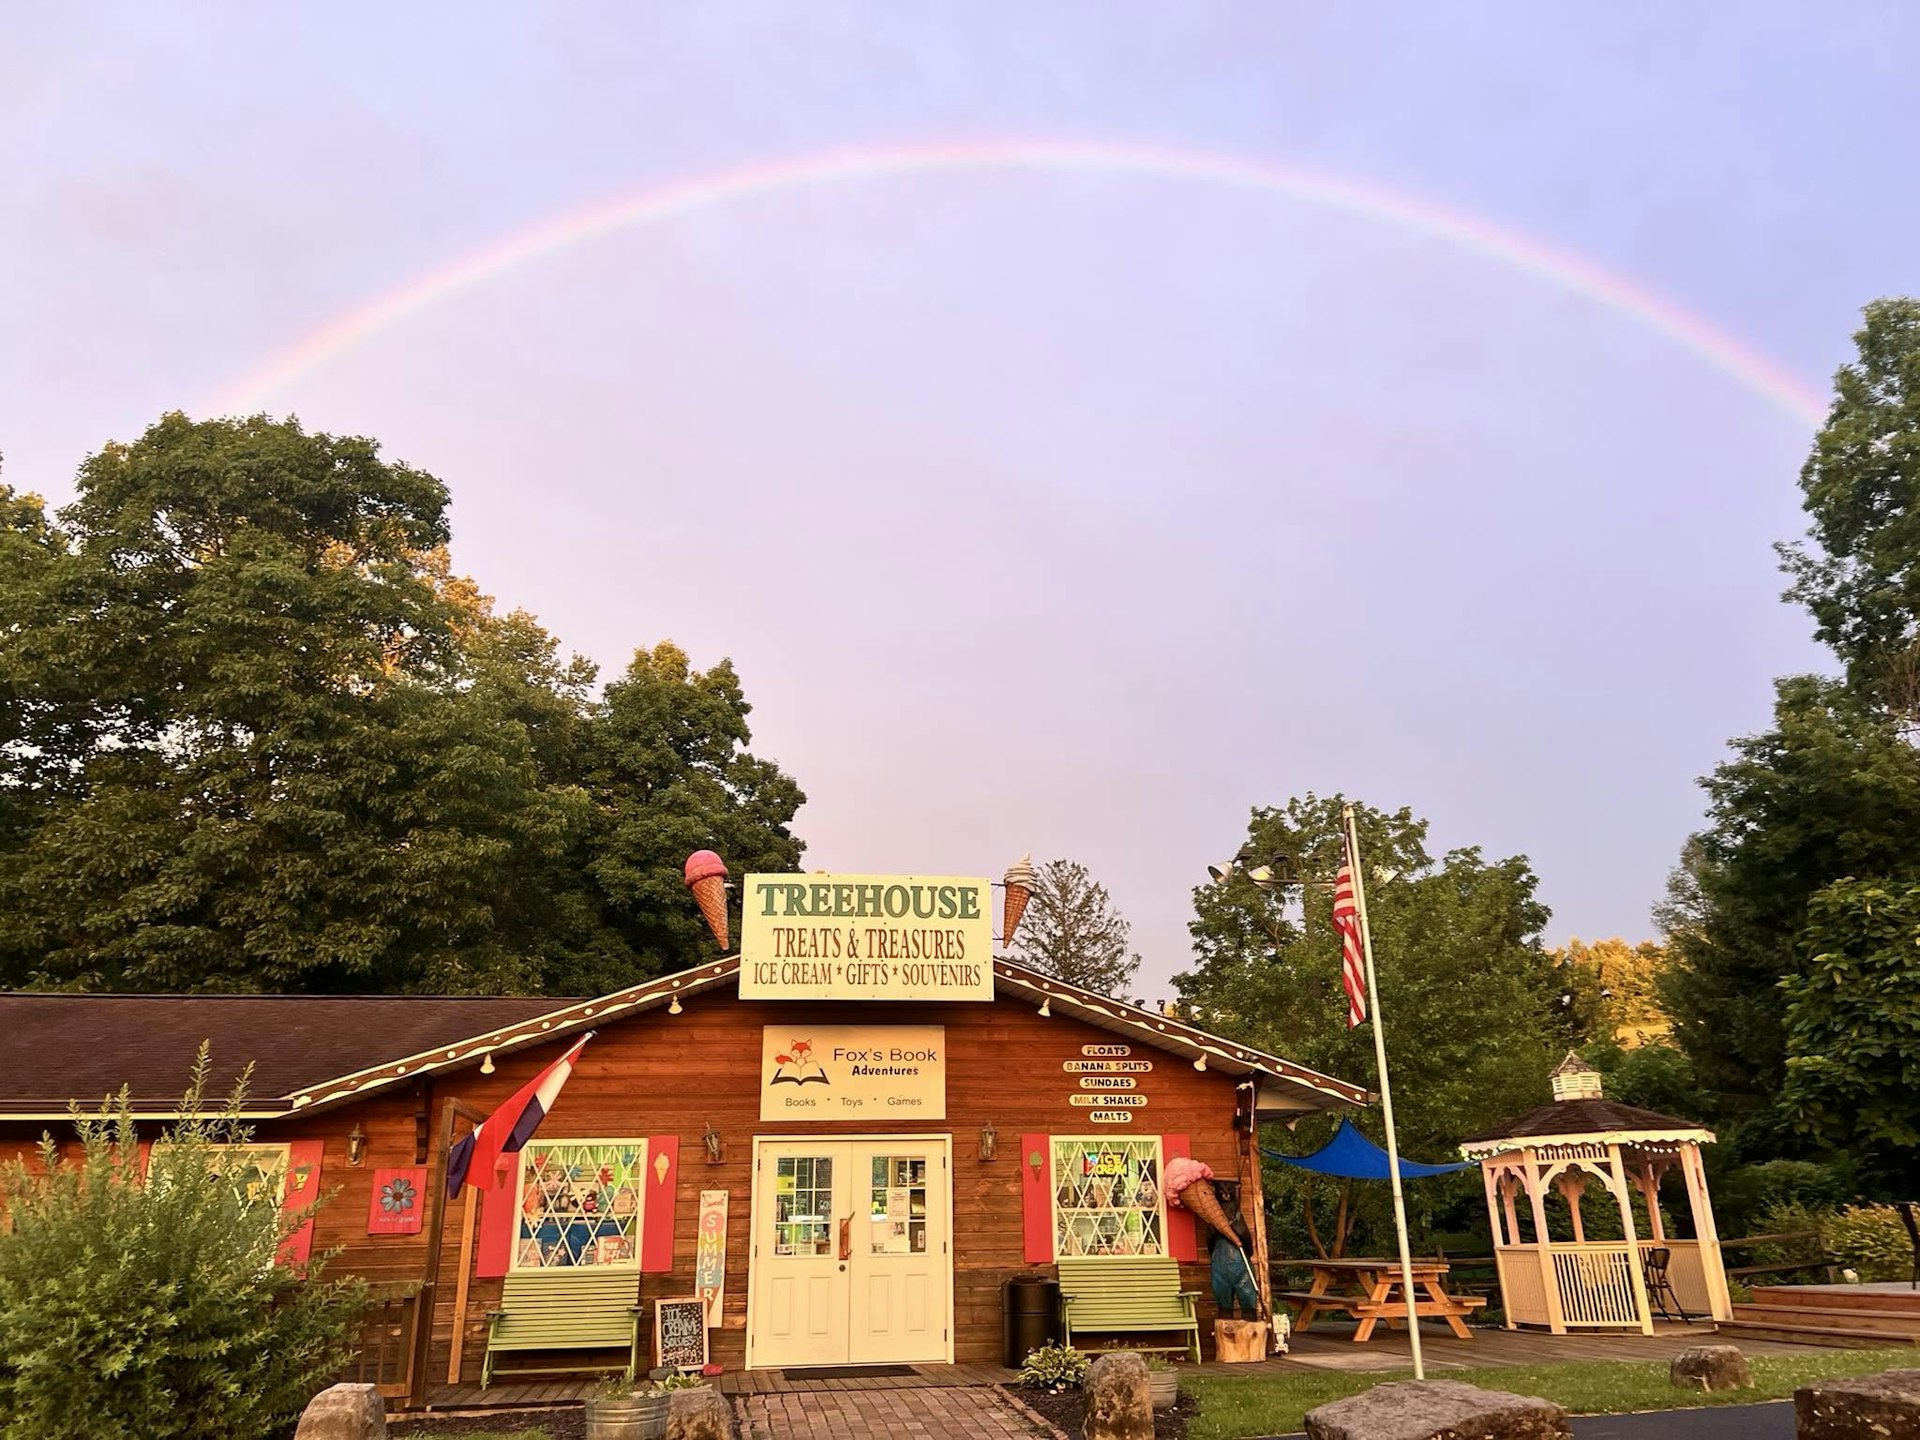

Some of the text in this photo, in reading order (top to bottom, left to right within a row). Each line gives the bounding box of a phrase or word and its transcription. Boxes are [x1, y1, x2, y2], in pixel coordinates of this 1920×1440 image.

[756, 883, 981, 919] TREEHOUSE
[772, 927, 965, 960] TREATS & TREASURES
[753, 962, 981, 987] ICE CREAM GIFTS SOUVENIRS
[833, 1048, 937, 1062] Fox's Book
[1086, 1046, 1126, 1055] FLOATS
[852, 1065, 919, 1076] Adventures
[1066, 1062, 1149, 1071] BANANA SPLITS
[1084, 1078, 1131, 1087] SUNDAES
[785, 1096, 922, 1109] Books Toys Games
[1074, 1096, 1144, 1105] MILK SHAKES
[1093, 1112, 1128, 1121] MALTS
[1100, 1154, 1122, 1165] ICE
[1095, 1164, 1127, 1175] CREAM
[703, 1214, 718, 1301] SUMMER
